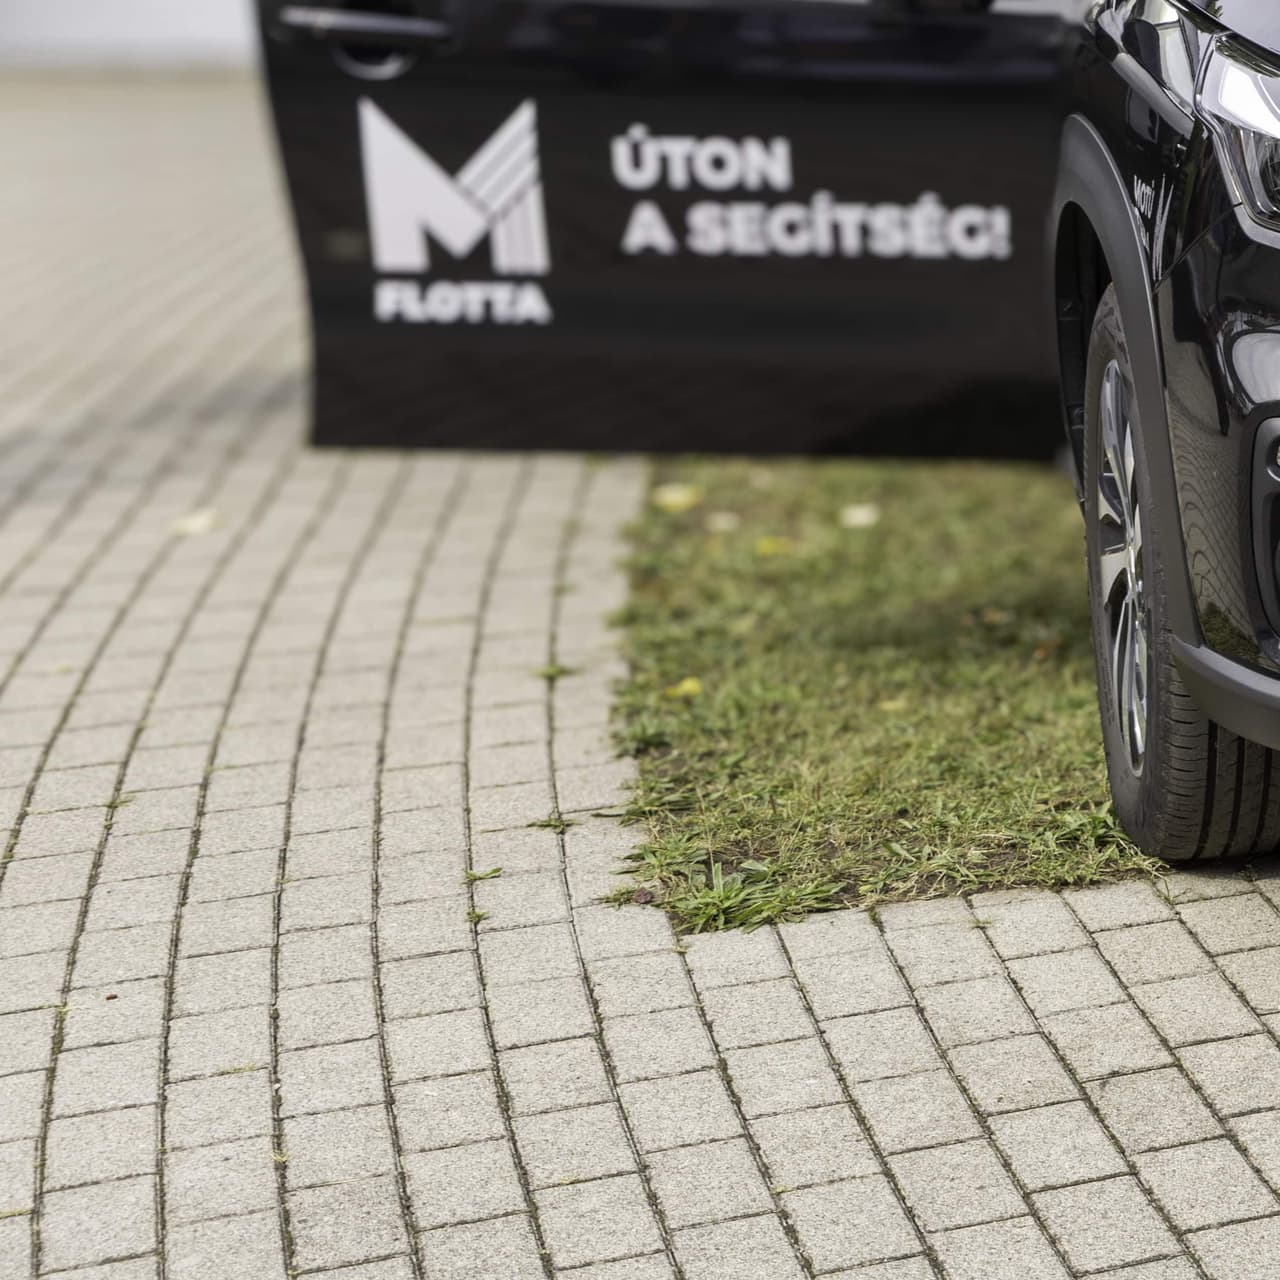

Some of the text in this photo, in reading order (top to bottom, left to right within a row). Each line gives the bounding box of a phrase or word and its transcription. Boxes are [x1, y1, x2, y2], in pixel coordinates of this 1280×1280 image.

[610, 122, 794, 192] ÚTON
[622, 189, 1012, 261] A SEGÍTSÉG!
[374, 279, 551, 324] FLOTTA
